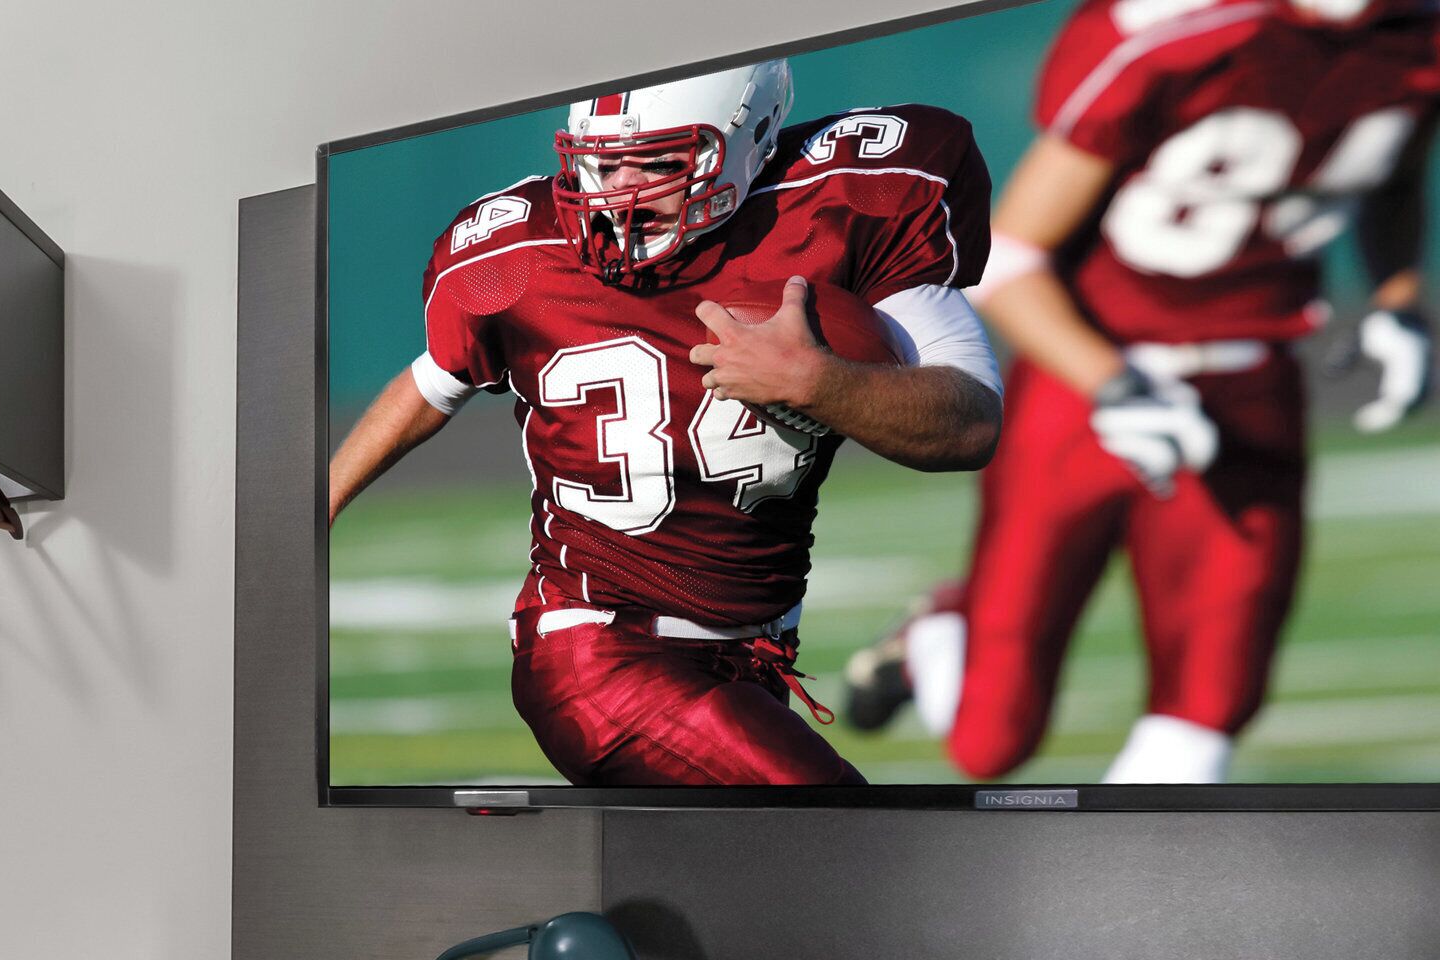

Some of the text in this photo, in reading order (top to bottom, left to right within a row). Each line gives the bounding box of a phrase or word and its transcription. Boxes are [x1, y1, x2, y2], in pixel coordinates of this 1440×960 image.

[450, 195, 532, 255] 4
[538, 335, 817, 536] 34
[985, 795, 1066, 805] INSIGNIA
